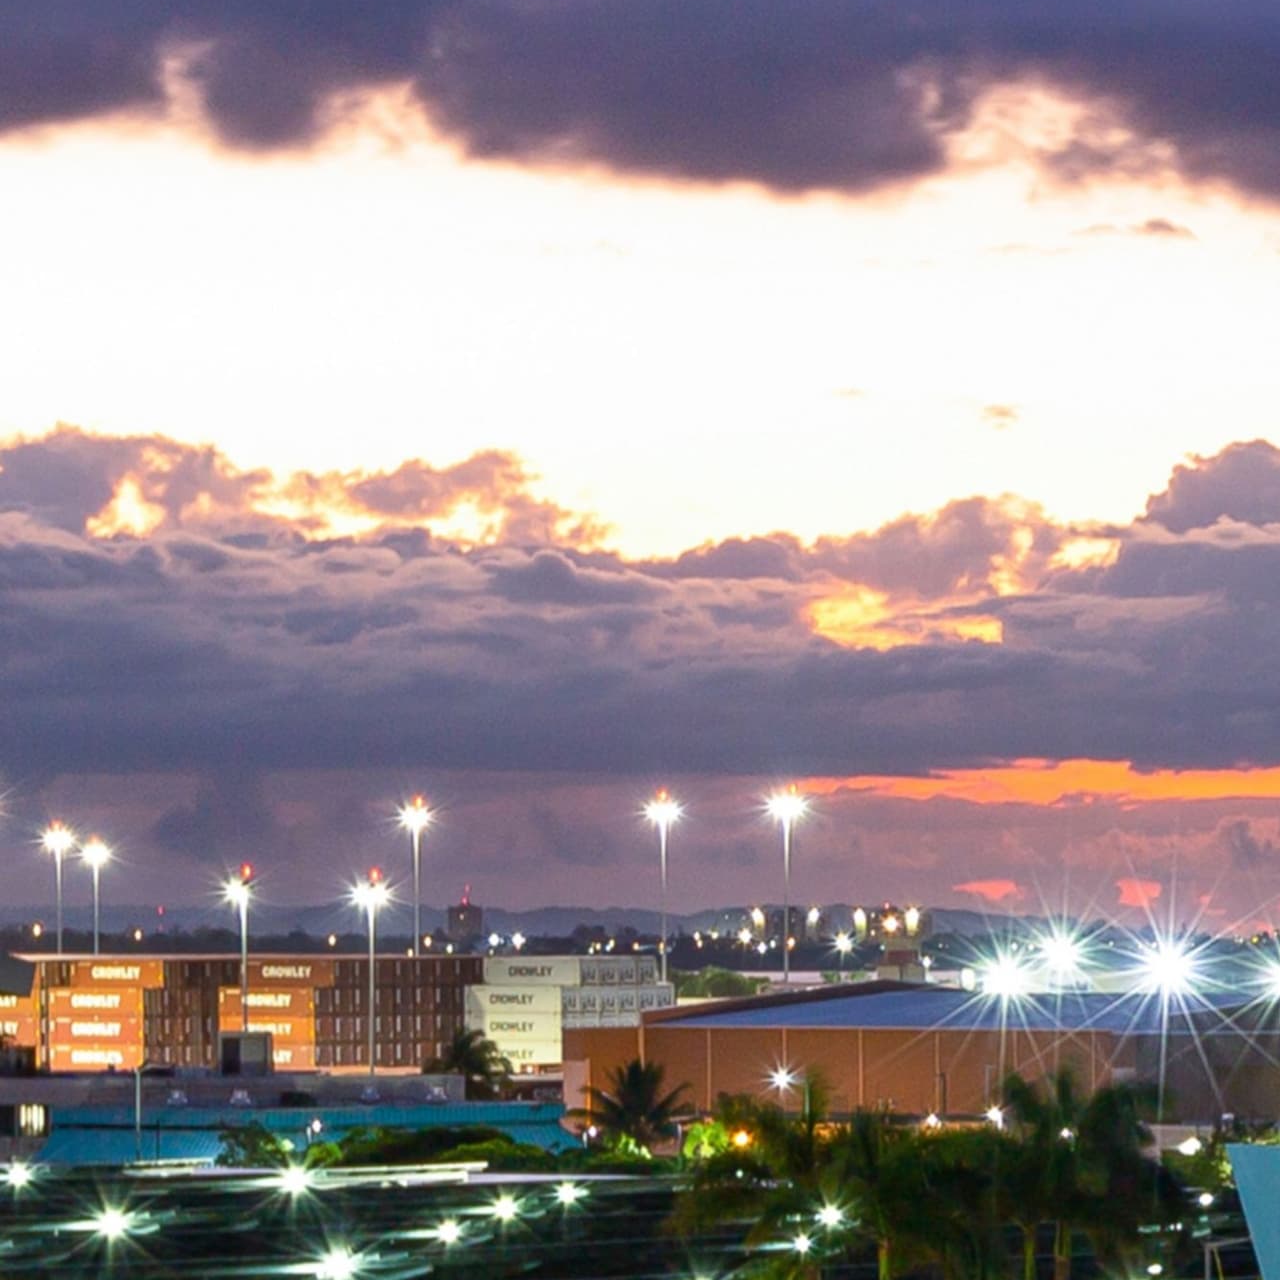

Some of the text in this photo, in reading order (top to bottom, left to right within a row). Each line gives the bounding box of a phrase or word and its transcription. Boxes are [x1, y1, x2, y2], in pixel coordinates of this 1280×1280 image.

[262, 965, 311, 978] CROWLEY
[508, 966, 553, 977] CROWLEY
[490, 994, 534, 1005] CROWLEY
[490, 1021, 534, 1032] CROWLEY
